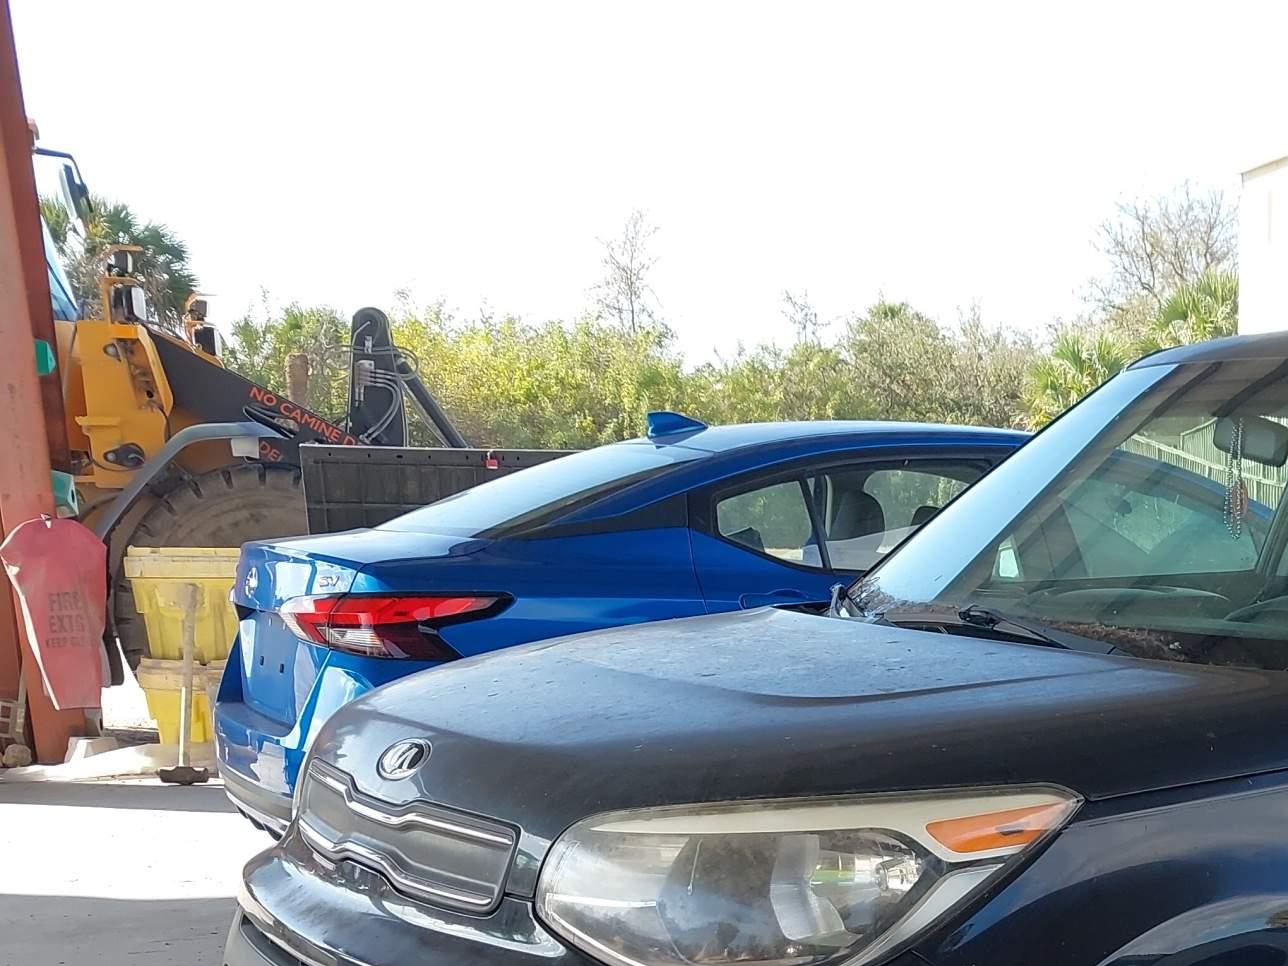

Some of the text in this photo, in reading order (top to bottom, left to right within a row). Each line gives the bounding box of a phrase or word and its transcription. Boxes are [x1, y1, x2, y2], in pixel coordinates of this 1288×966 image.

[249, 386, 277, 406] NO
[280, 403, 342, 441] CAMINE
[319, 576, 340, 588] SV
